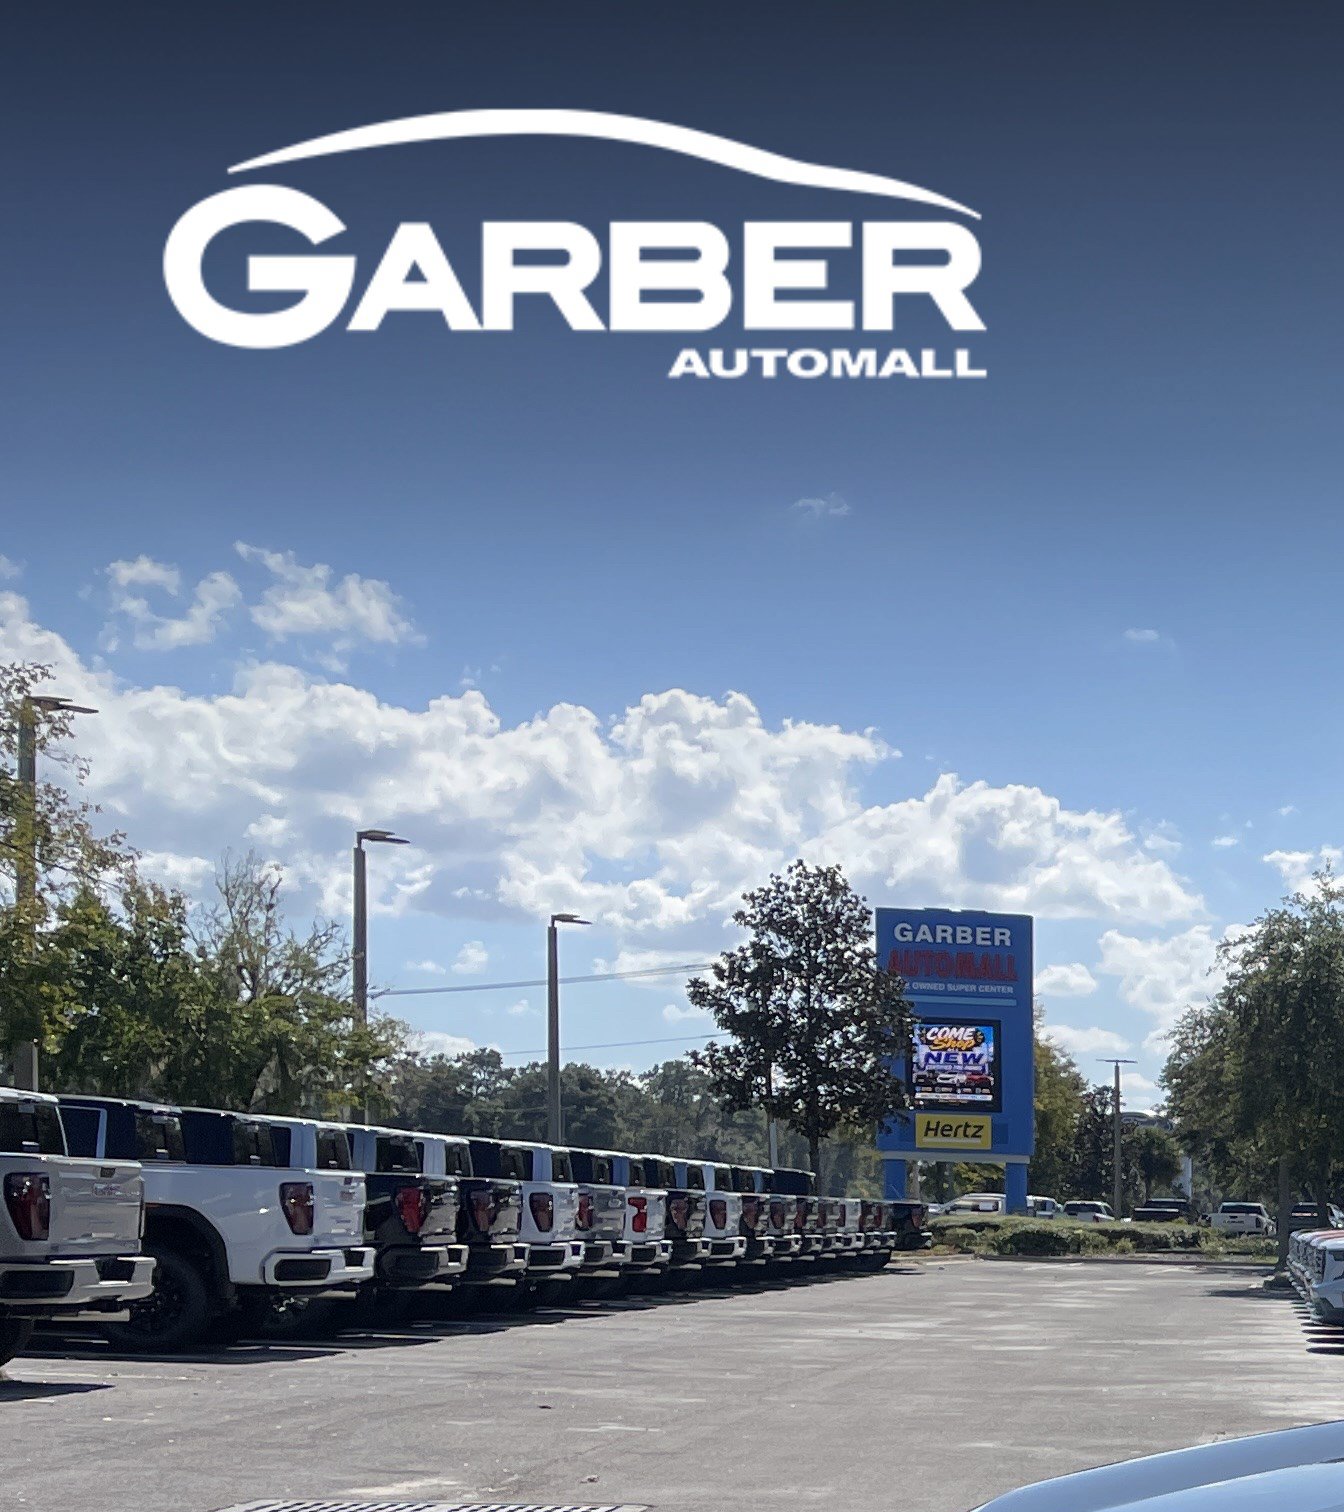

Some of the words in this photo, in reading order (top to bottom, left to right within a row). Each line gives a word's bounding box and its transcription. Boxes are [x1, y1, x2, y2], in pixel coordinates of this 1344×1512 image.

[894, 923, 1011, 946] GARBER
[889, 950, 1017, 980] AUTOMALL
[912, 982, 945, 991] OWNED
[946, 983, 977, 993] SUPER
[978, 985, 1014, 994] CENTER
[926, 1026, 976, 1041] COME
[923, 1051, 984, 1064] NEW
[923, 1119, 985, 1139] Hertz
